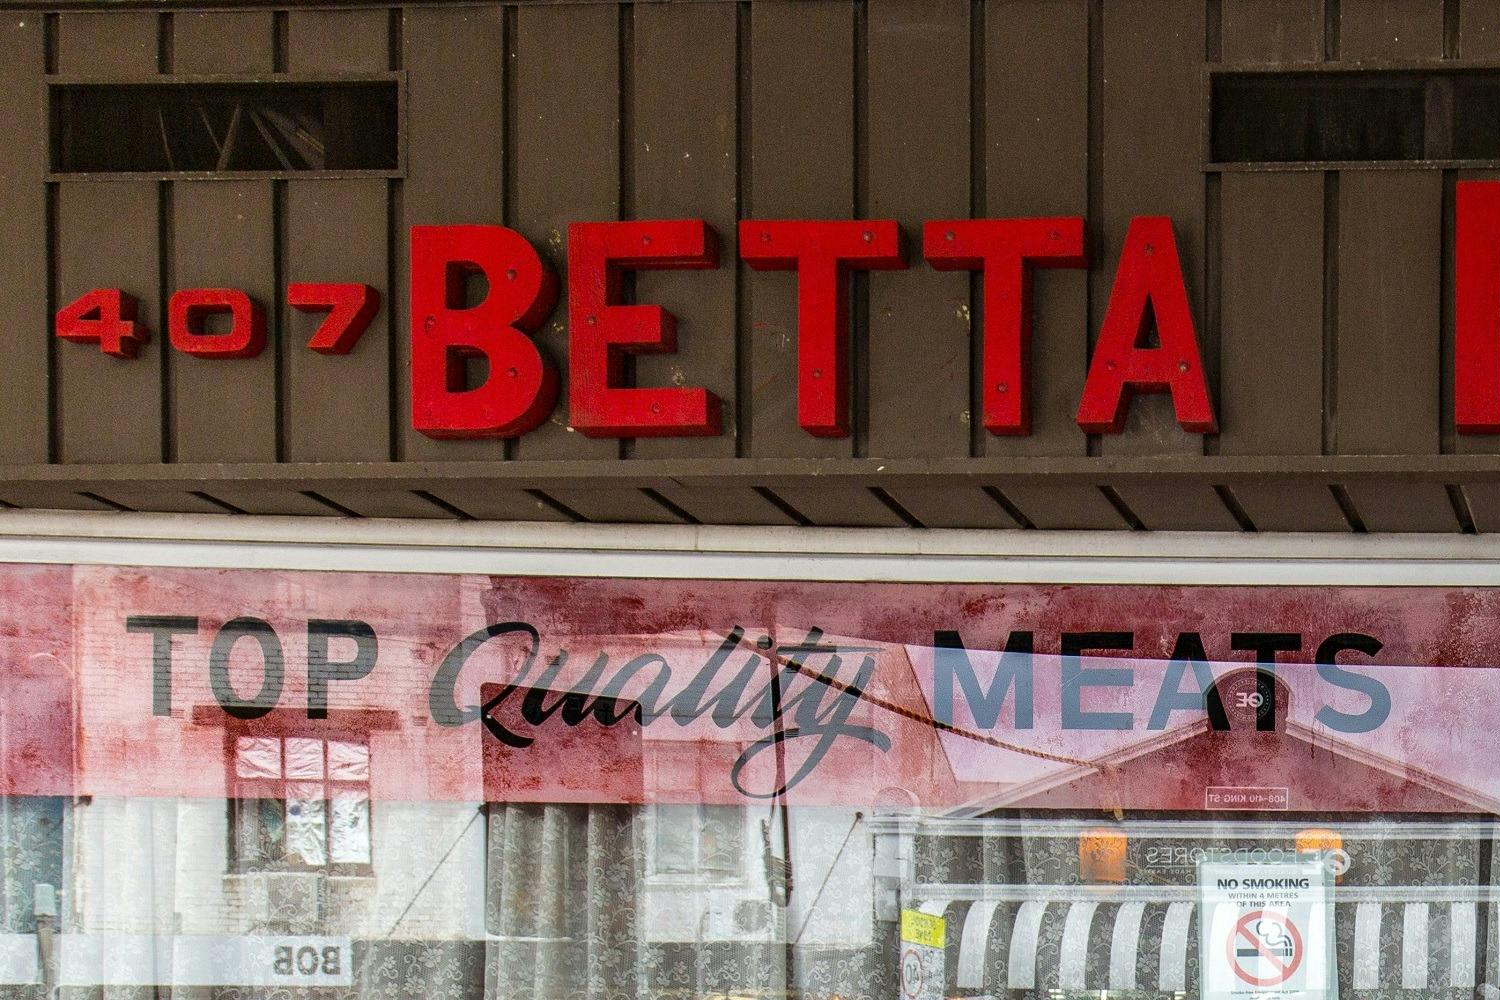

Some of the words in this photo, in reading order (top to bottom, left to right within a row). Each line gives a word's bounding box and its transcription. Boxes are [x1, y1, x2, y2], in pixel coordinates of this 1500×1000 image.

[55, 281, 381, 360] 407
[410, 213, 1219, 440] BETTA
[126, 614, 381, 720] TOP
[429, 620, 893, 799] Quality
[933, 629, 1392, 734] MEATS
[1216, 878, 1239, 890] NO
[1242, 878, 1310, 890] SMOKING
